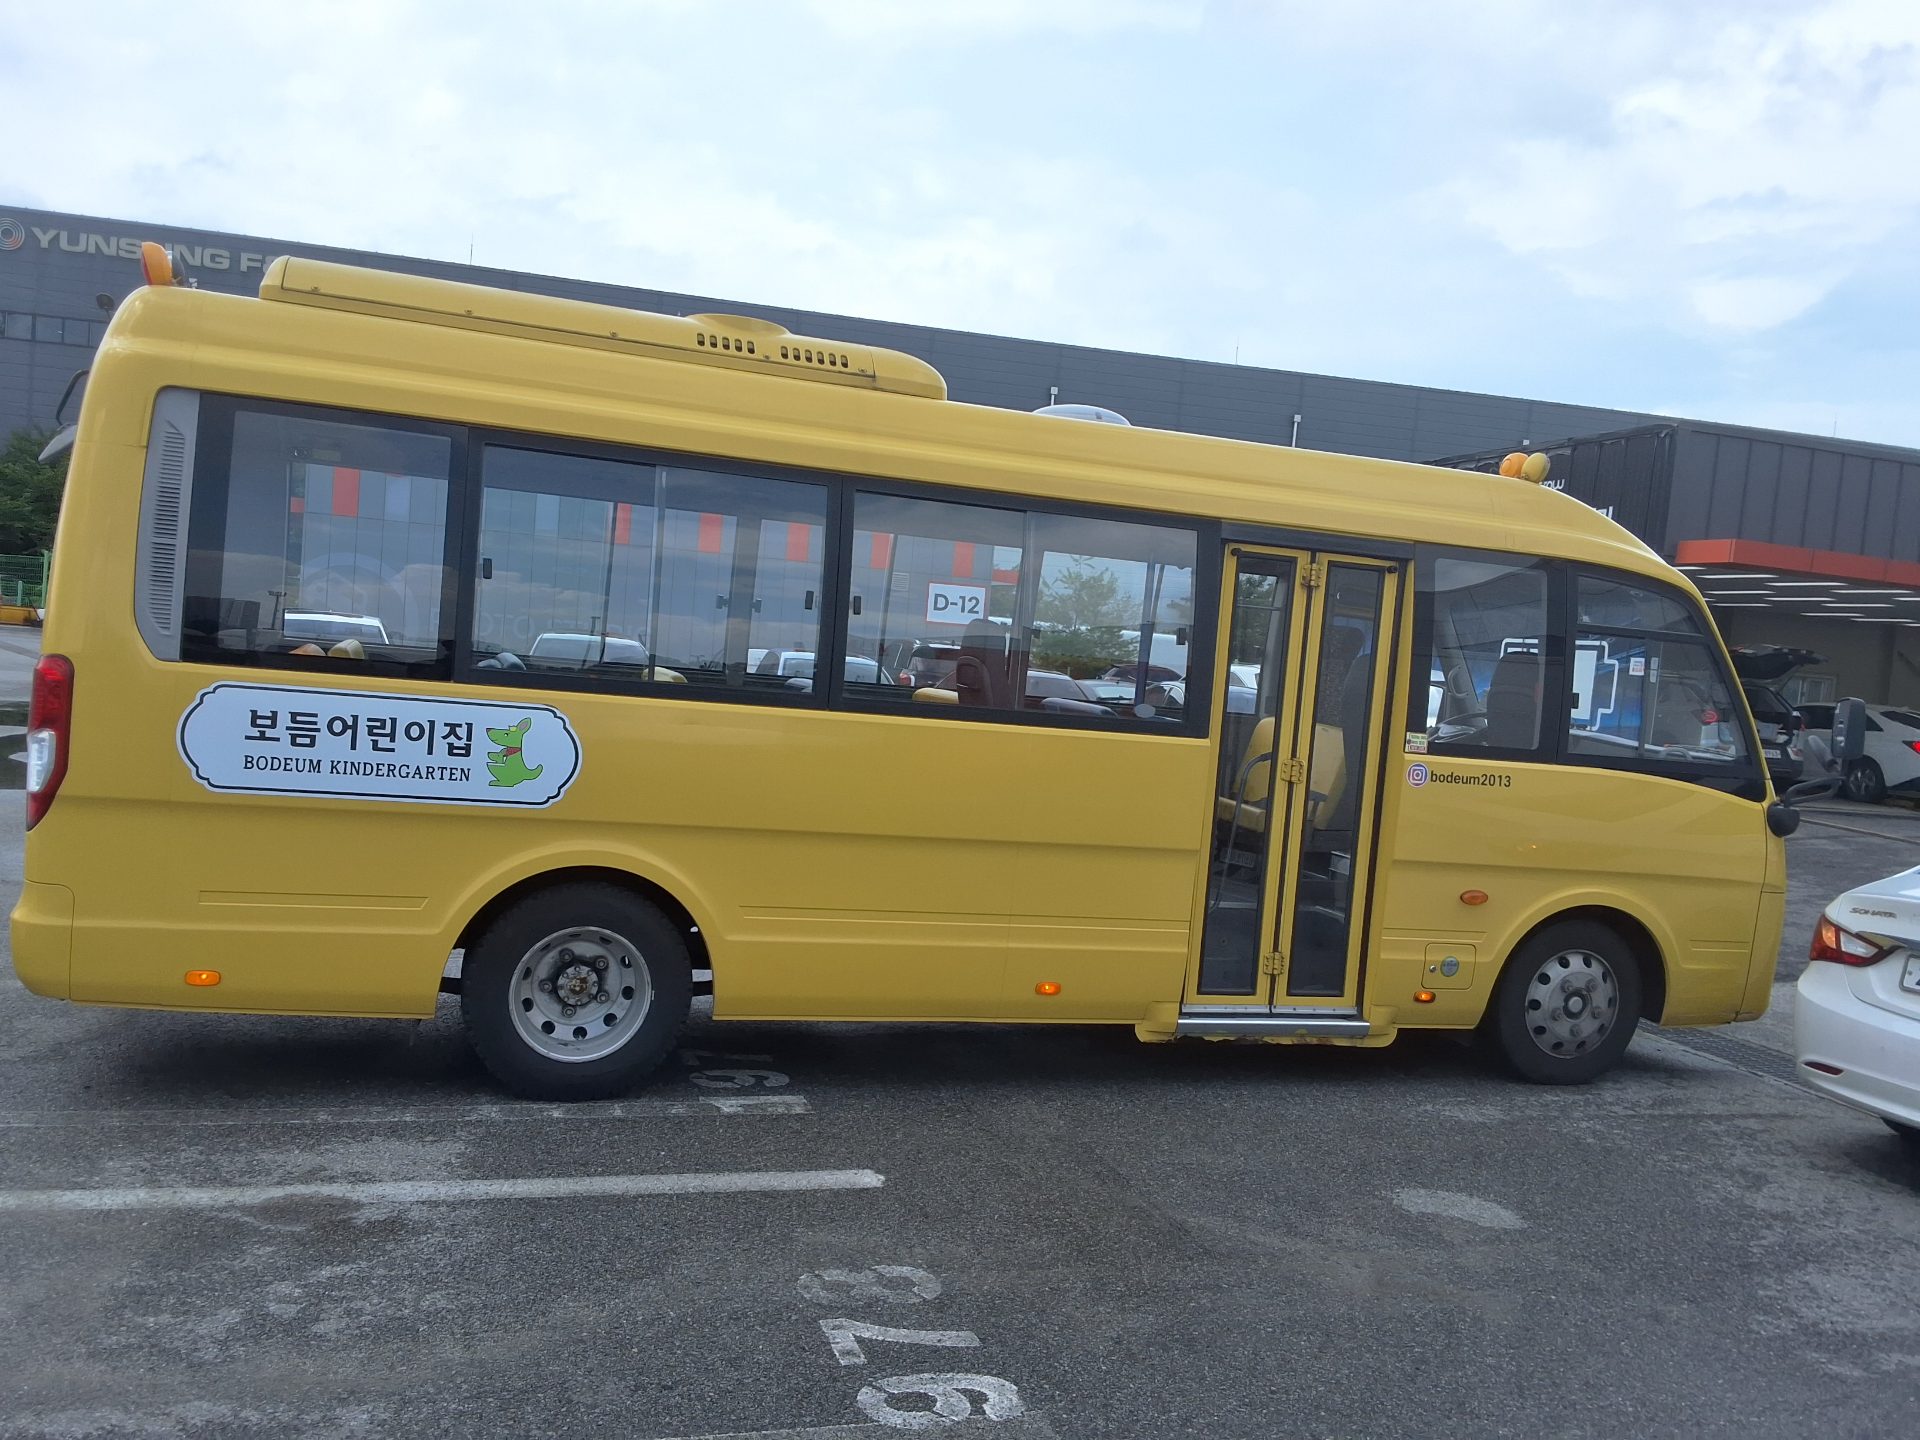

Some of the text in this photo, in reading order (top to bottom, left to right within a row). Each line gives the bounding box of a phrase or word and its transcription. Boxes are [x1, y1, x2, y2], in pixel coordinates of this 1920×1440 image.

[30, 227, 230, 270] YUNSNG
[932, 592, 981, 615] D-12
[244, 709, 474, 758] 보듬어린이집
[243, 754, 472, 782] BODEUM KINDERGARTEN
[1430, 769, 1512, 788] bodeum2013
